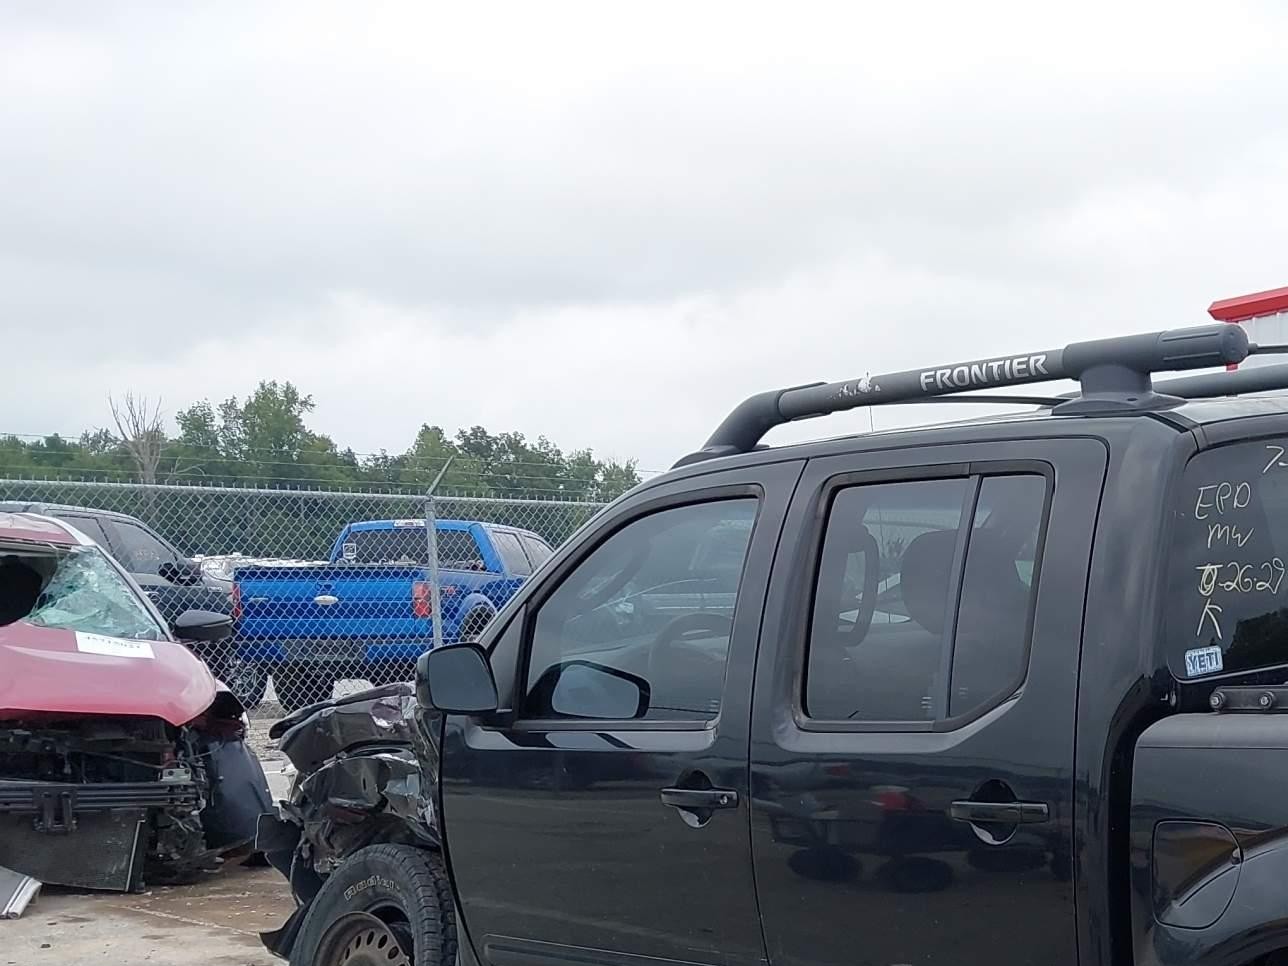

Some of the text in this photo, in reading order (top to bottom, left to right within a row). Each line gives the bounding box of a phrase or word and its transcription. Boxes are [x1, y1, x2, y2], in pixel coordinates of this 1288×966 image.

[920, 354, 1049, 392] FRONTIER
[1195, 482, 1251, 520] EPD
[1187, 651, 1221, 675] YETI
